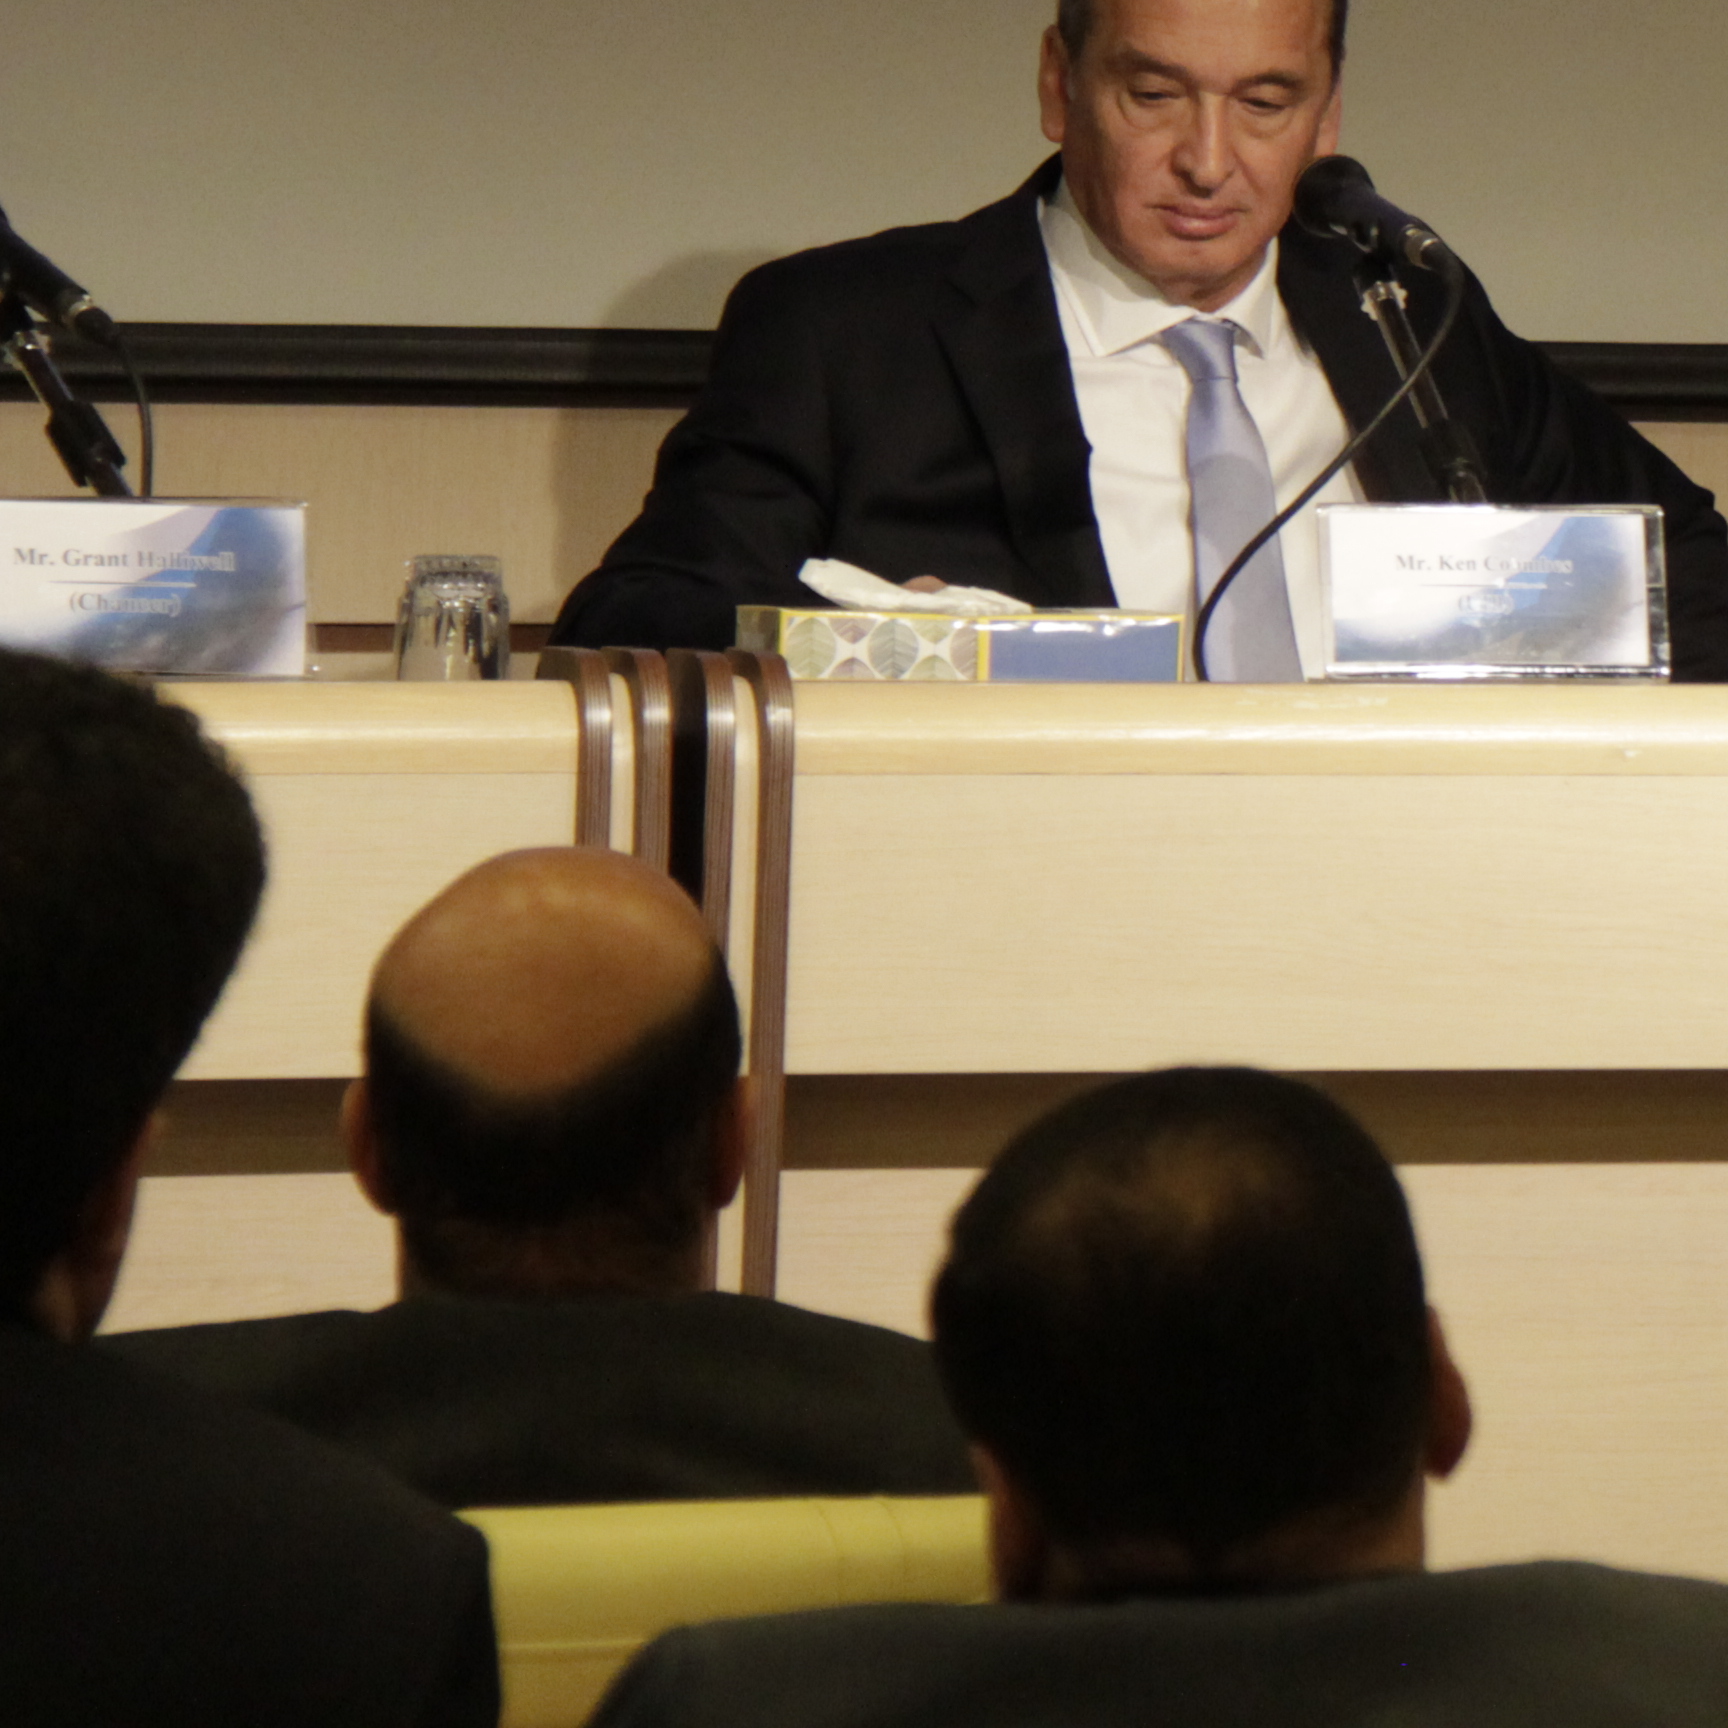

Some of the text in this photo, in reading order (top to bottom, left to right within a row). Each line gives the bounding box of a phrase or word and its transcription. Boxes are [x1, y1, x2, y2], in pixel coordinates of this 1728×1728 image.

[13, 547, 54, 567] Mr.
[62, 548, 130, 568] Grant
[1395, 553, 1432, 572] Mr.
[1438, 554, 1477, 572] Ken
